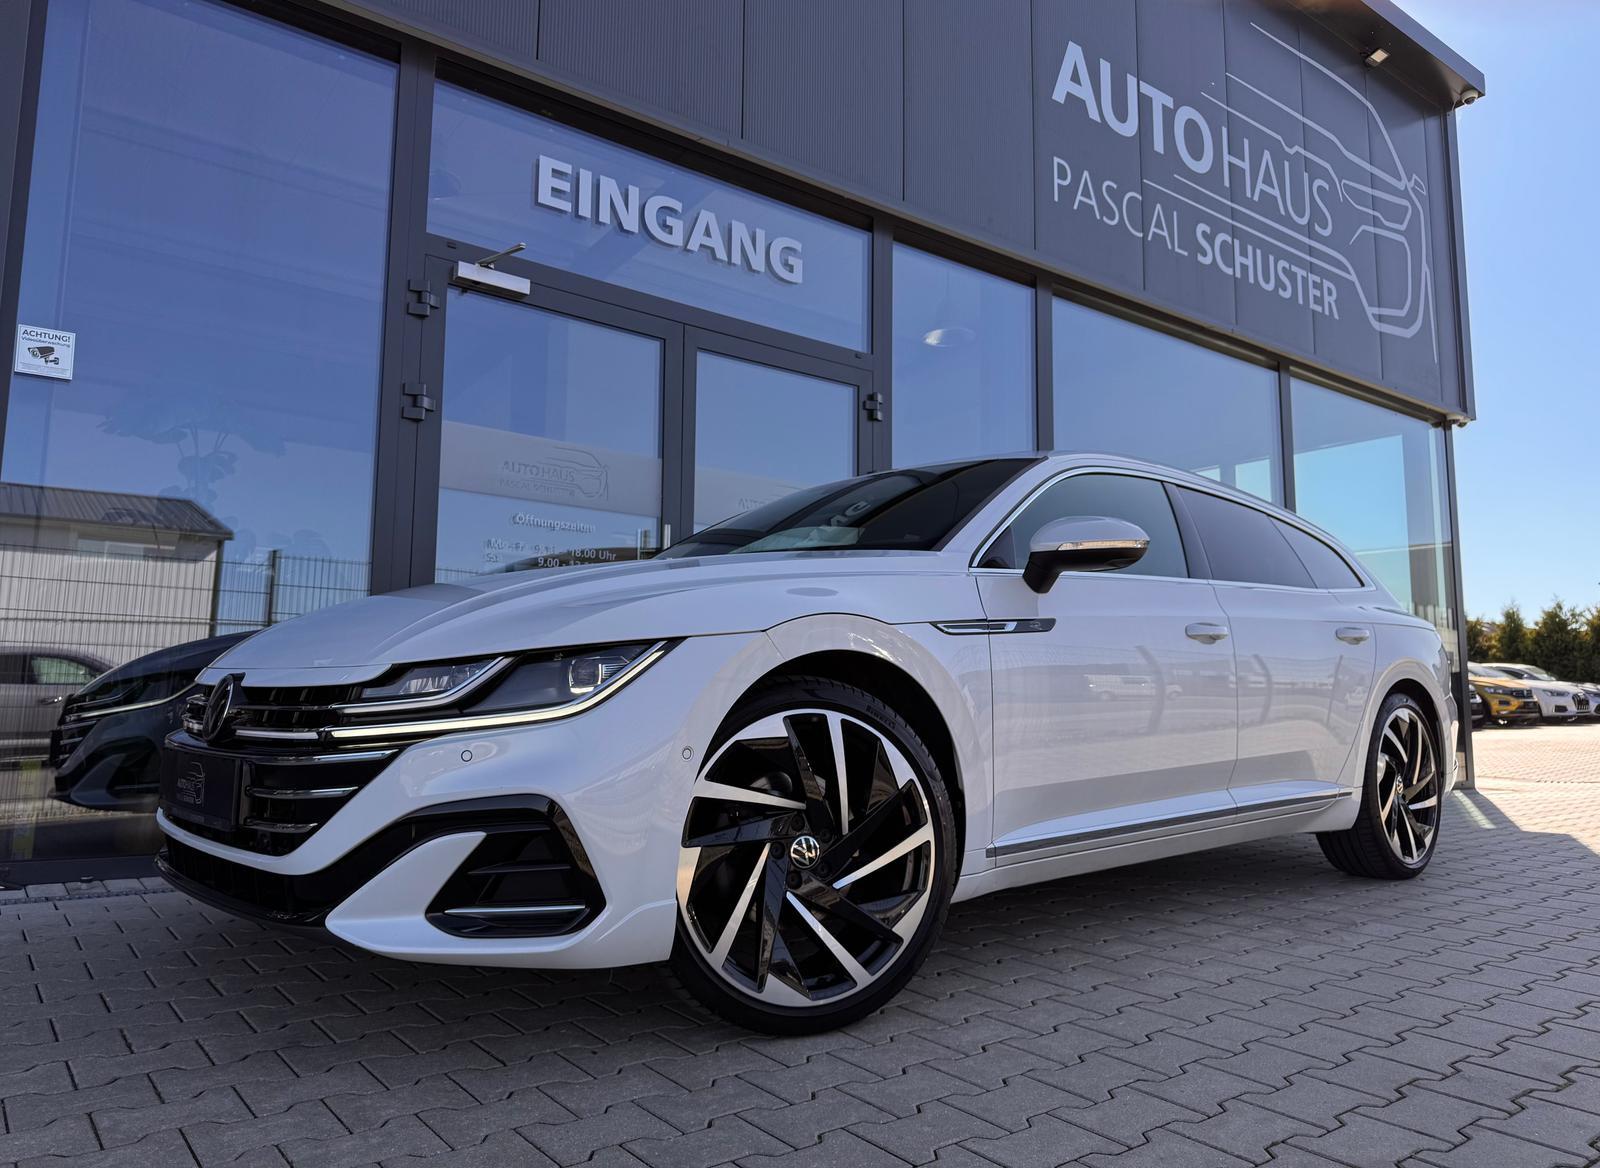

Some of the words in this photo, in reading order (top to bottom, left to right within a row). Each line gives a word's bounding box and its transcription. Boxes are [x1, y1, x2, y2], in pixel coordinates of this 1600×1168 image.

[536, 154, 804, 284] EINGANG
[1053, 156, 1188, 257] PASCAL
[1195, 223, 1339, 320] SCHUSTER
[22, 329, 71, 343] ACHTUNG!
[537, 556, 560, 568] 9.00
[598, 549, 617, 561] Uhr
